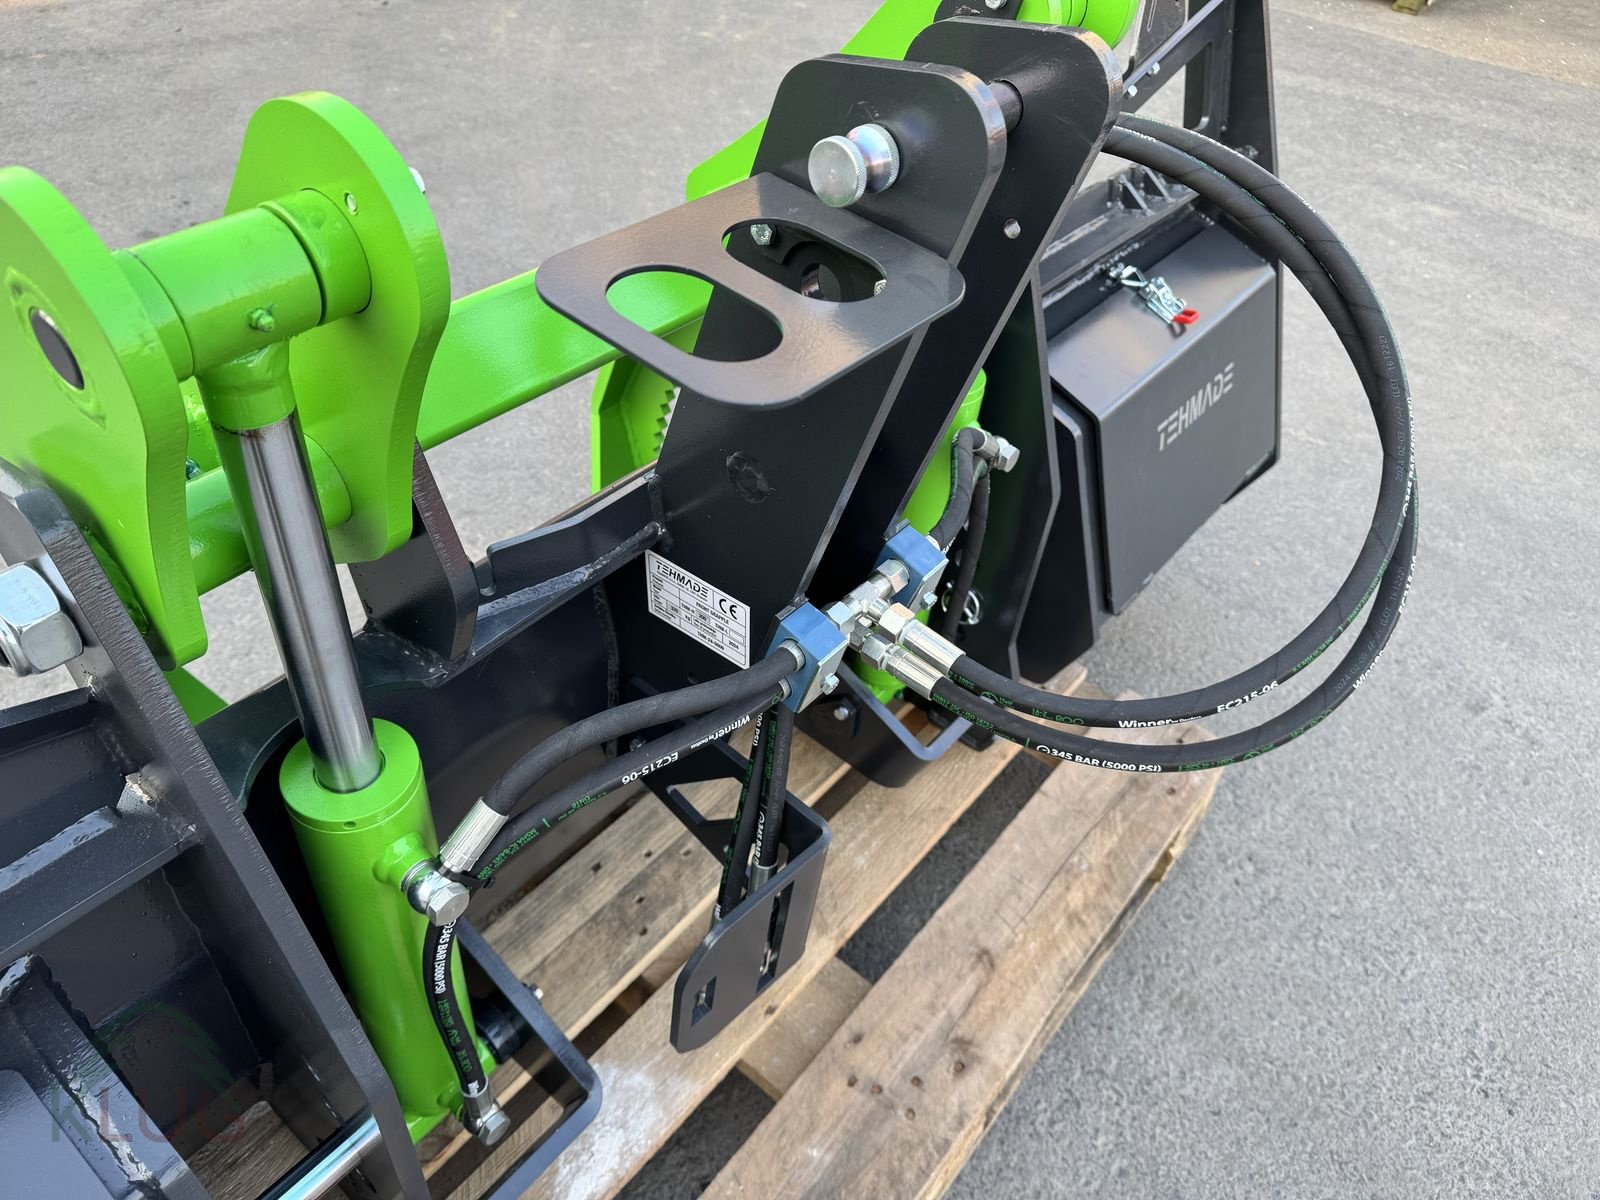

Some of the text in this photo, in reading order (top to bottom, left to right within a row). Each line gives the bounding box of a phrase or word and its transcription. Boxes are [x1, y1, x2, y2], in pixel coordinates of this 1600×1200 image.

[1157, 361, 1235, 452] TEHMADE
[656, 560, 708, 598] TEHMADE
[710, 609, 729, 625] GRAPPLE
[713, 714, 751, 741] Winner
[1118, 718, 1173, 728] Winner
[621, 752, 679, 785] EC215-06
[1050, 749, 1162, 773] 345 BAR (5000 PSI)
[438, 925, 453, 947] 345
[435, 944, 448, 963] BAR
